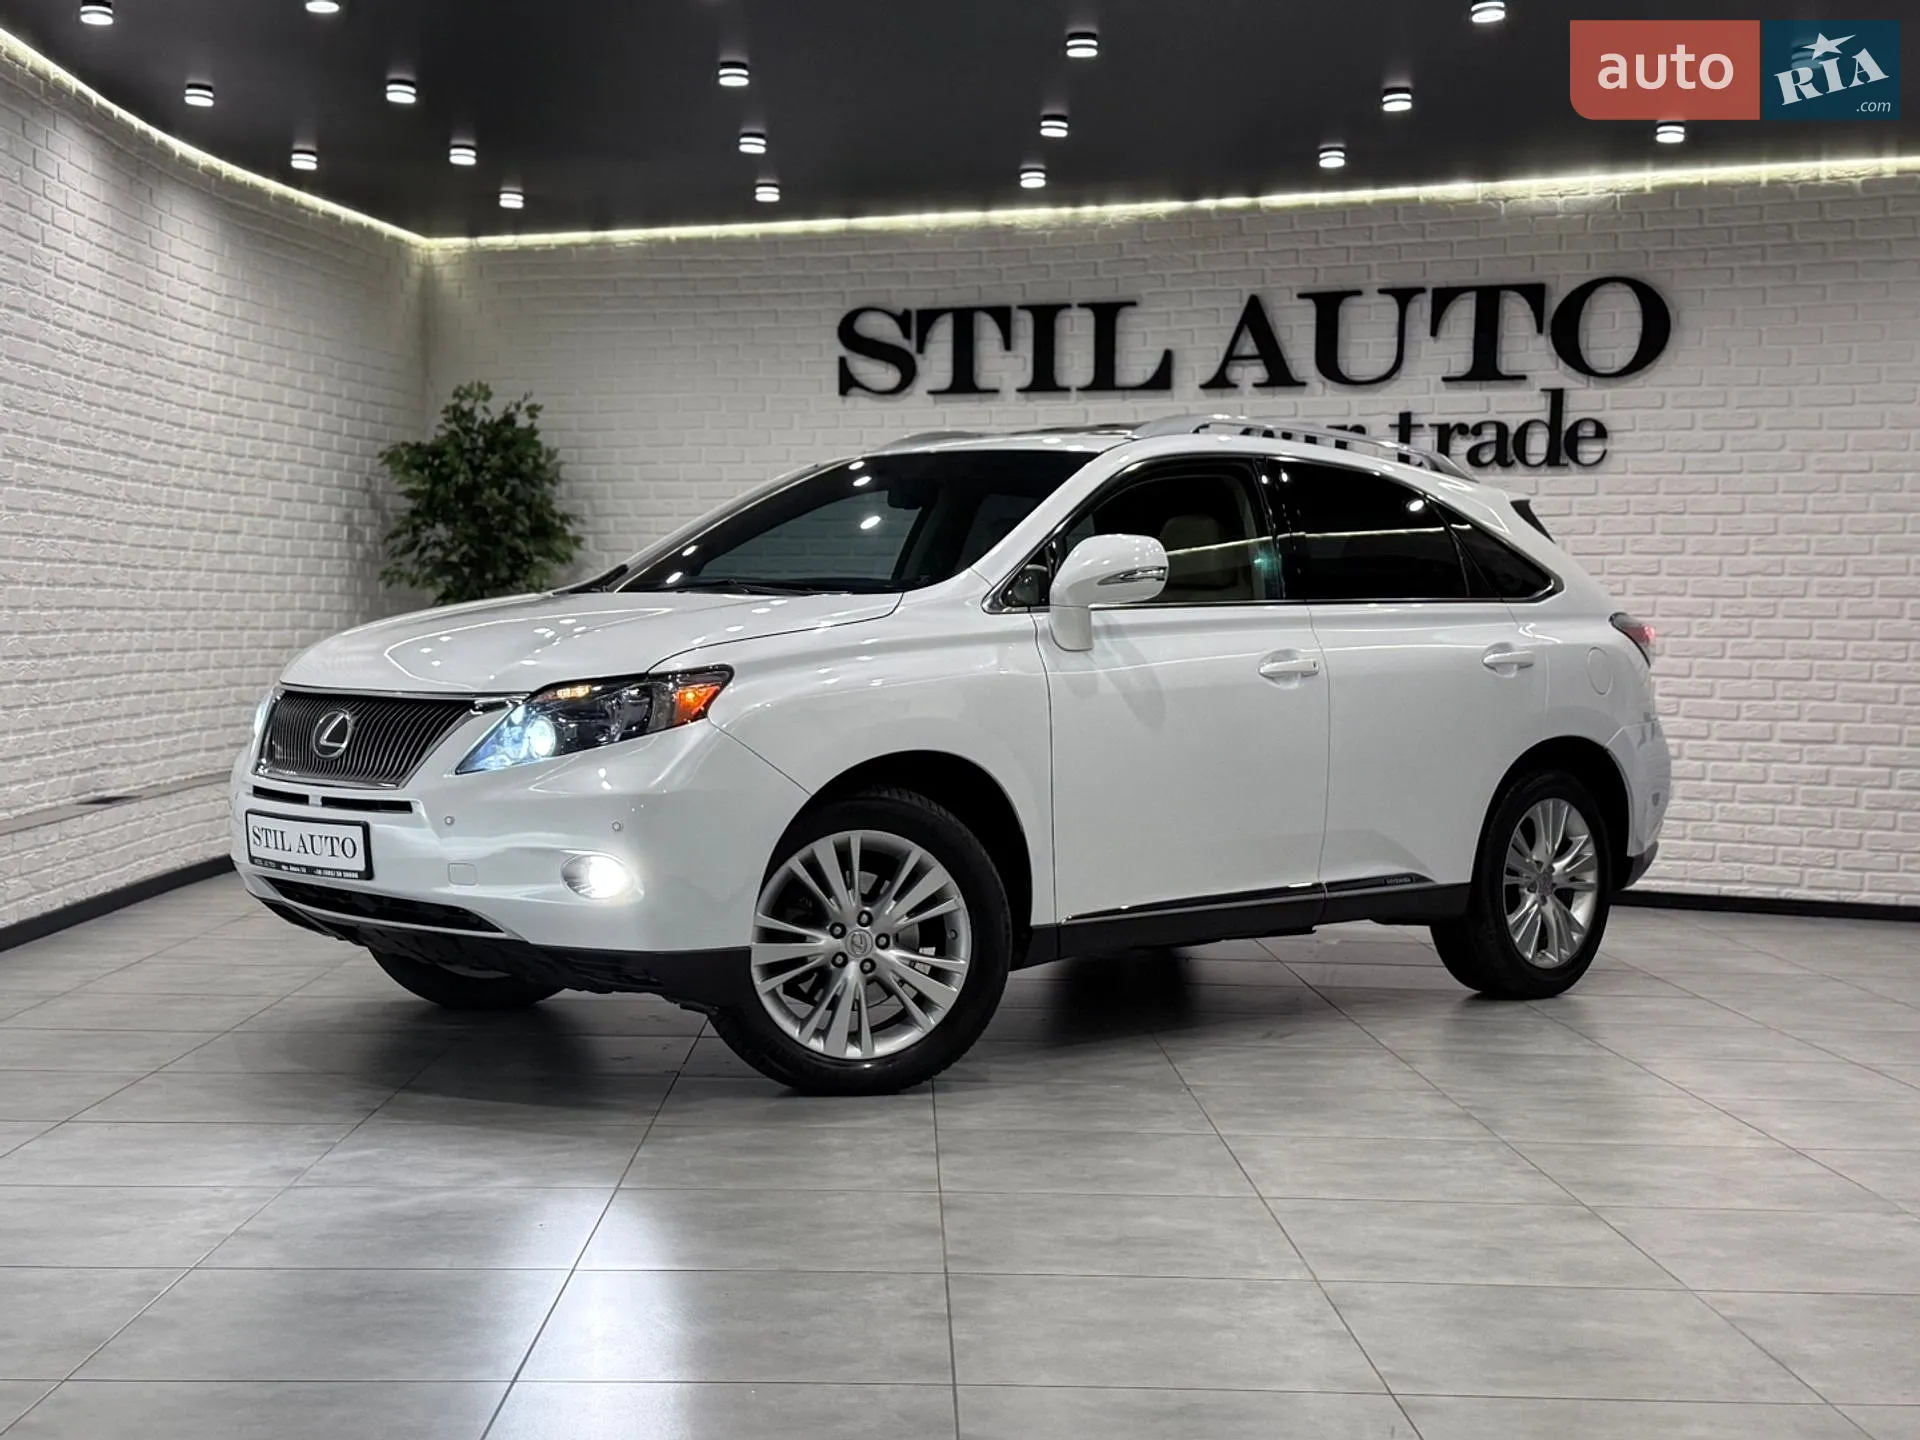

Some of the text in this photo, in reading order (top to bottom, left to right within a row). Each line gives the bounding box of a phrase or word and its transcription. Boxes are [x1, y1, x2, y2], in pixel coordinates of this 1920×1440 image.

[837, 276, 1672, 397] STIL AUTO
[1388, 387, 1608, 469] trade
[251, 825, 357, 859] STIL AUTO
